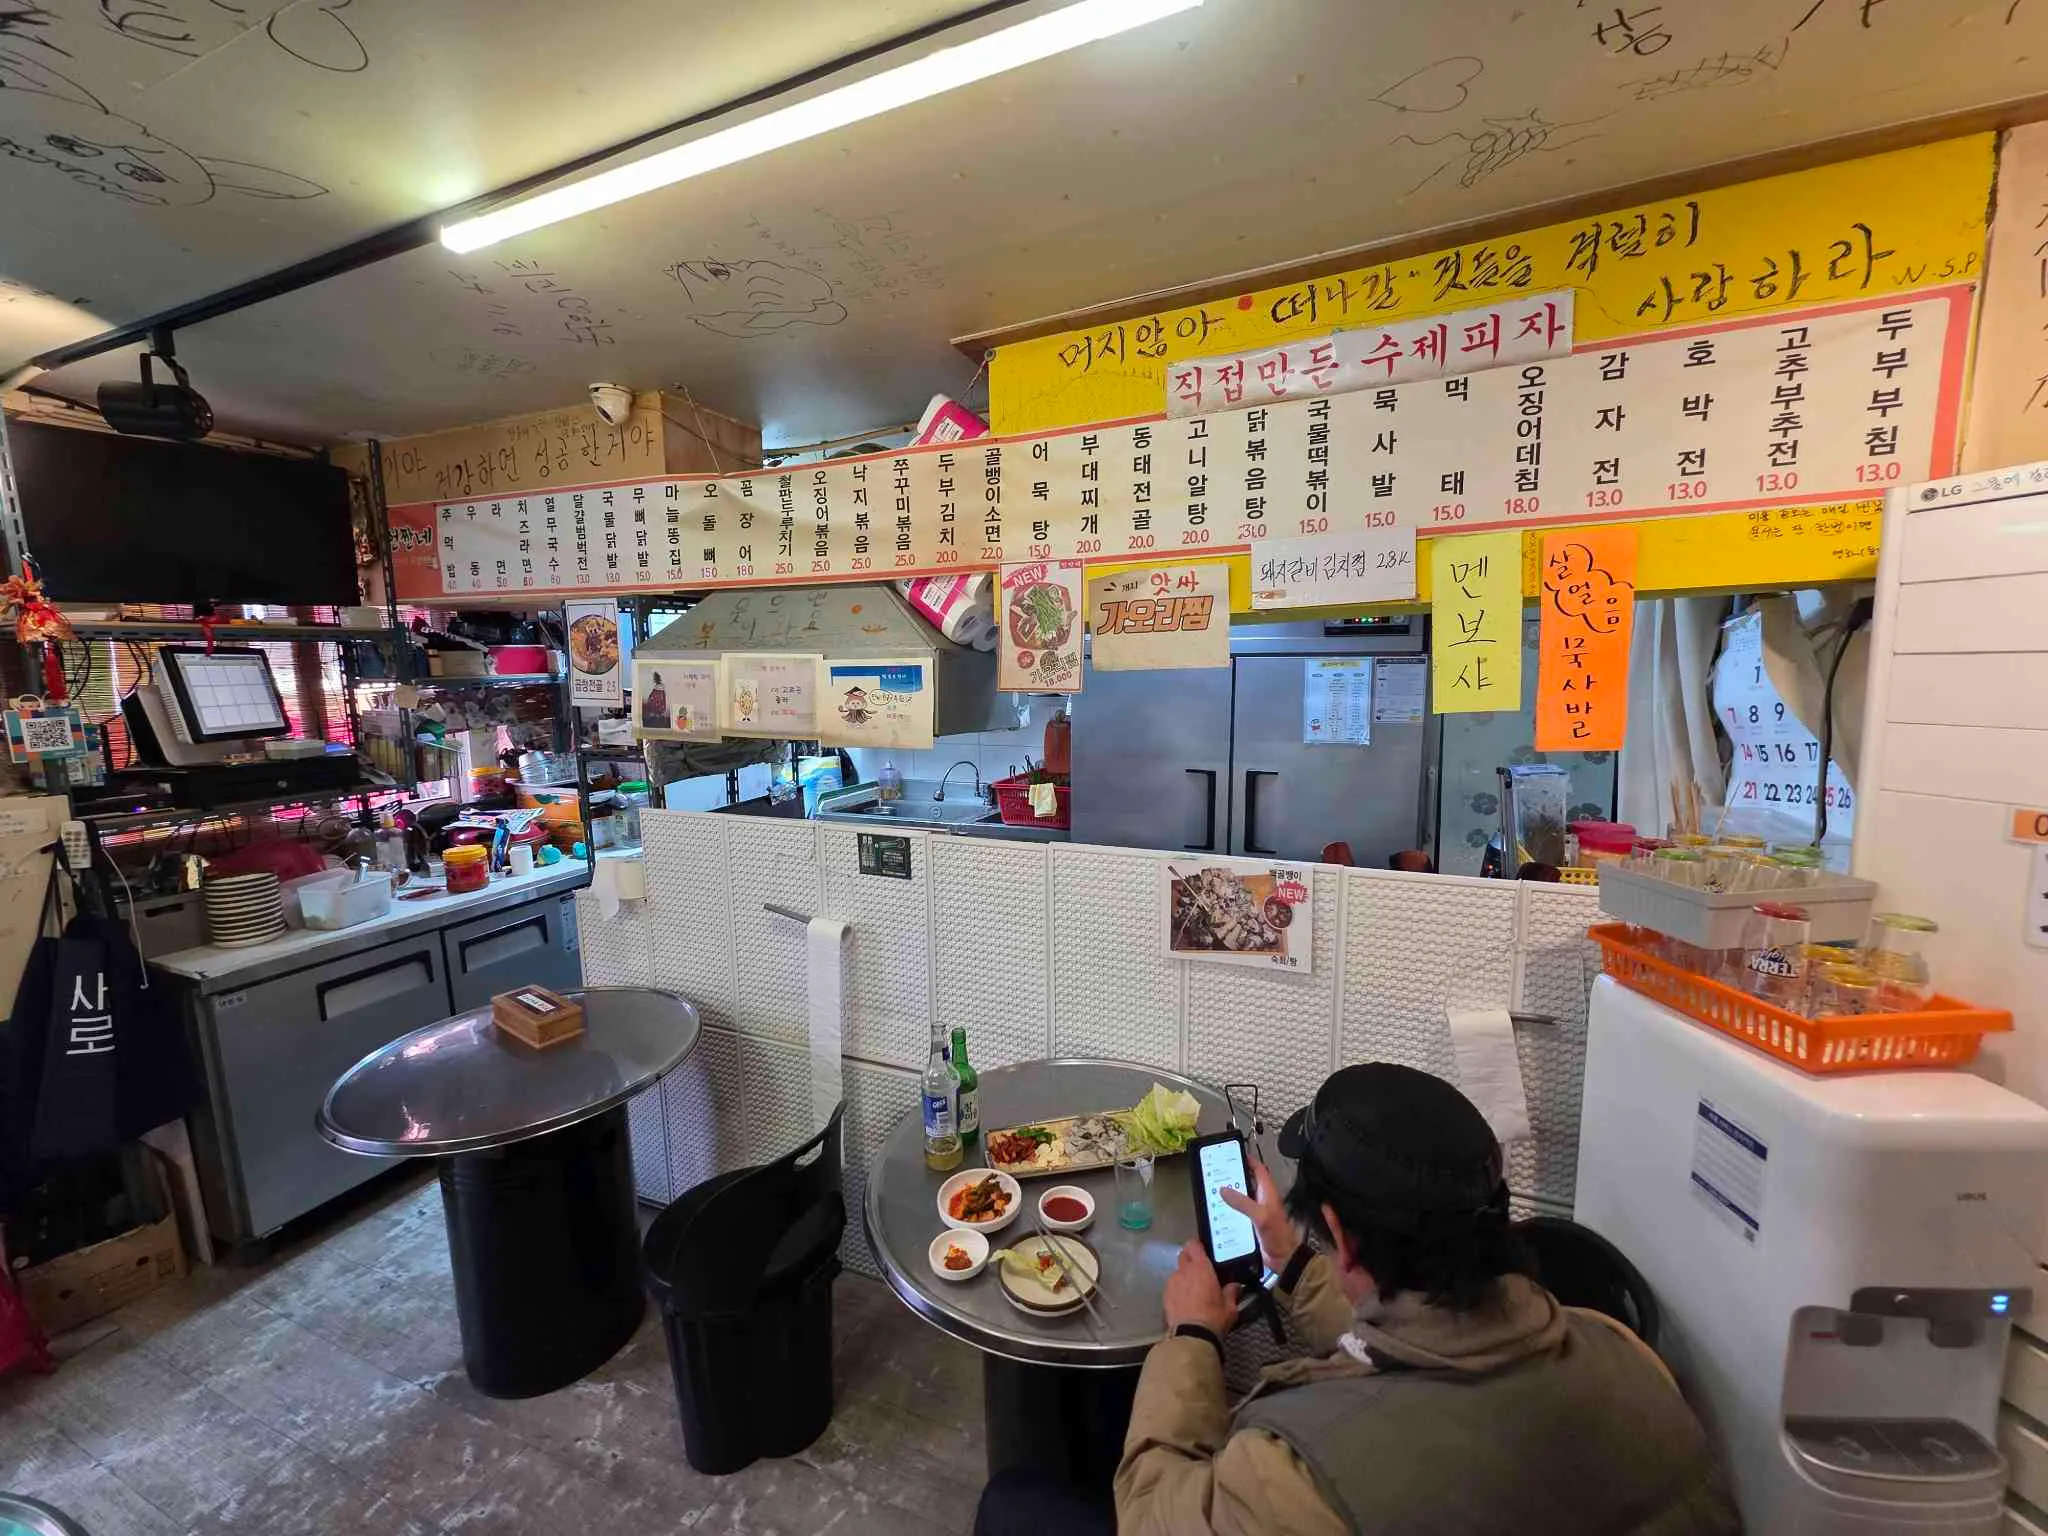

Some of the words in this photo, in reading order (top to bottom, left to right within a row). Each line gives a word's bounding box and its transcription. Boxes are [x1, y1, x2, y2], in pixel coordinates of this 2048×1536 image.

[1059, 310, 1226, 375] 머지않아
[1271, 264, 1401, 324] 떠나갈
[1433, 244, 1534, 302] 것들을
[1565, 202, 1699, 282] 격렬히
[1636, 222, 1897, 323] 사랑하라
[1360, 301, 1566, 378] 수제피자
[1592, 352, 1630, 486] 감자전
[1676, 340, 1716, 477] 호박전
[1767, 326, 1812, 468] 고추부추전
[1864, 308, 1914, 458] 두부부침
[1244, 409, 1268, 521] 닭볶음탕
[1305, 398, 1331, 514] 국물떡볶이
[1371, 389, 1398, 498] 묵사발
[1440, 376, 1468, 496] 먹태
[1513, 365, 1547, 493] 오징어데침
[853, 464, 870, 553] 낙지볶음
[892, 458, 911, 550] 쭈꾸미볶음
[938, 453, 955, 545] 두부김치
[984, 447, 1002, 542] 골뱅이소면
[1031, 441, 1050, 541] 어묵탕
[1080, 434, 1099, 535] 부대찌개
[1131, 427, 1153, 531] 동태전골
[1187, 419, 1209, 525] 고니알탕
[1504, 496, 1540, 515] 18.0
[1586, 488, 1624, 509] 13.0
[1666, 480, 1708, 502] 13.0
[1755, 471, 1799, 494] 13.0
[1854, 461, 1902, 484] 13.0
[1941, 484, 1963, 498] LG
[442, 508, 456, 578] 주먹밥
[467, 504, 481, 577] 우동
[492, 503, 507, 575] 라면
[517, 500, 532, 574] 치즈라면
[544, 497, 560, 573] 열무국수
[602, 491, 618, 569] 국물닭발
[633, 488, 649, 567] 무뼈닭발
[665, 485, 681, 566] 마늘똥집
[702, 483, 718, 564] 오돌뼈
[739, 480, 754, 561] 꼼장어
[812, 470, 830, 557] 오징어볶음
[1028, 543, 1051, 557] 15.0
[1076, 539, 1101, 552] 20.0
[1128, 534, 1154, 549] 20.0
[1182, 529, 1209, 544] 20.0
[1299, 517, 1328, 535] 15.0
[1364, 510, 1395, 528] 15.0
[1431, 503, 1465, 522] 15.0
[775, 562, 793, 574] 25.0
[811, 560, 830, 572] 25.0
[851, 557, 872, 569] 25.0
[895, 553, 915, 565] 25.0
[936, 551, 958, 563] 20.0
[980, 546, 1003, 560] 22.0
[1013, 566, 1044, 588] NEW
[1549, 549, 1620, 625] 살얼음
[1096, 595, 1214, 635] 가오리찜
[1447, 555, 1497, 690] 멘보샤
[1560, 636, 1598, 739] 묵사발
[1749, 705, 1759, 723] 8
[1774, 702, 1785, 721] 9
[1755, 744, 1769, 762] 15
[1775, 743, 1795, 762] 16
[1805, 742, 1818, 761] 17
[1744, 781, 1757, 800] 21
[1764, 783, 1781, 802] 22
[1785, 783, 1802, 803] 23
[1838, 787, 1851, 809] 26
[1278, 887, 1305, 901] NEW
